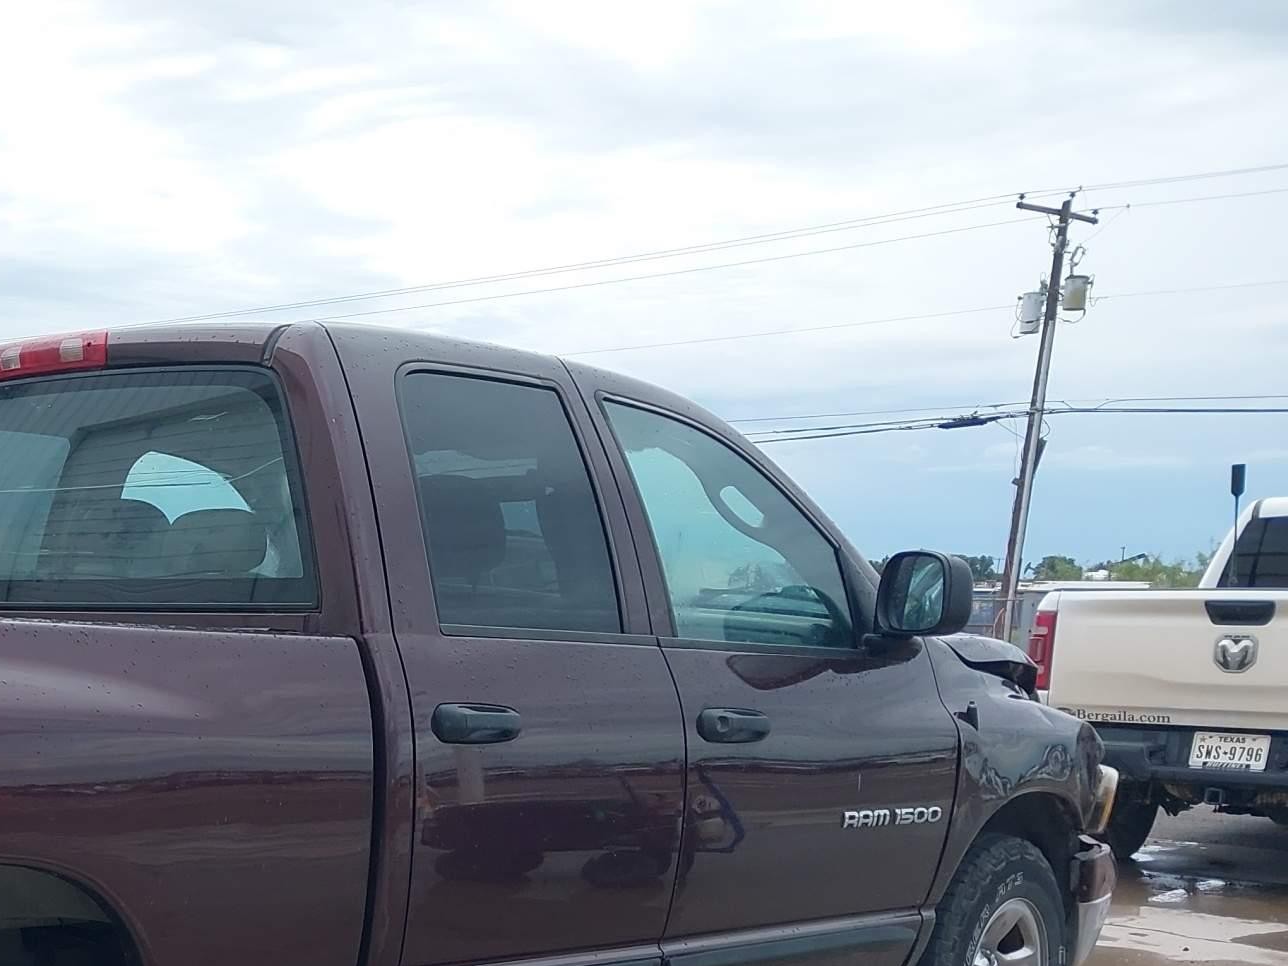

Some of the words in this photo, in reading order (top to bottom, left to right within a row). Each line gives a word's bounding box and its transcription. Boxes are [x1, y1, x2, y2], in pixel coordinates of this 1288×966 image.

[1218, 736, 1246, 744] TEXAS
[842, 809, 891, 829] RAM
[894, 806, 942, 825] 1500
